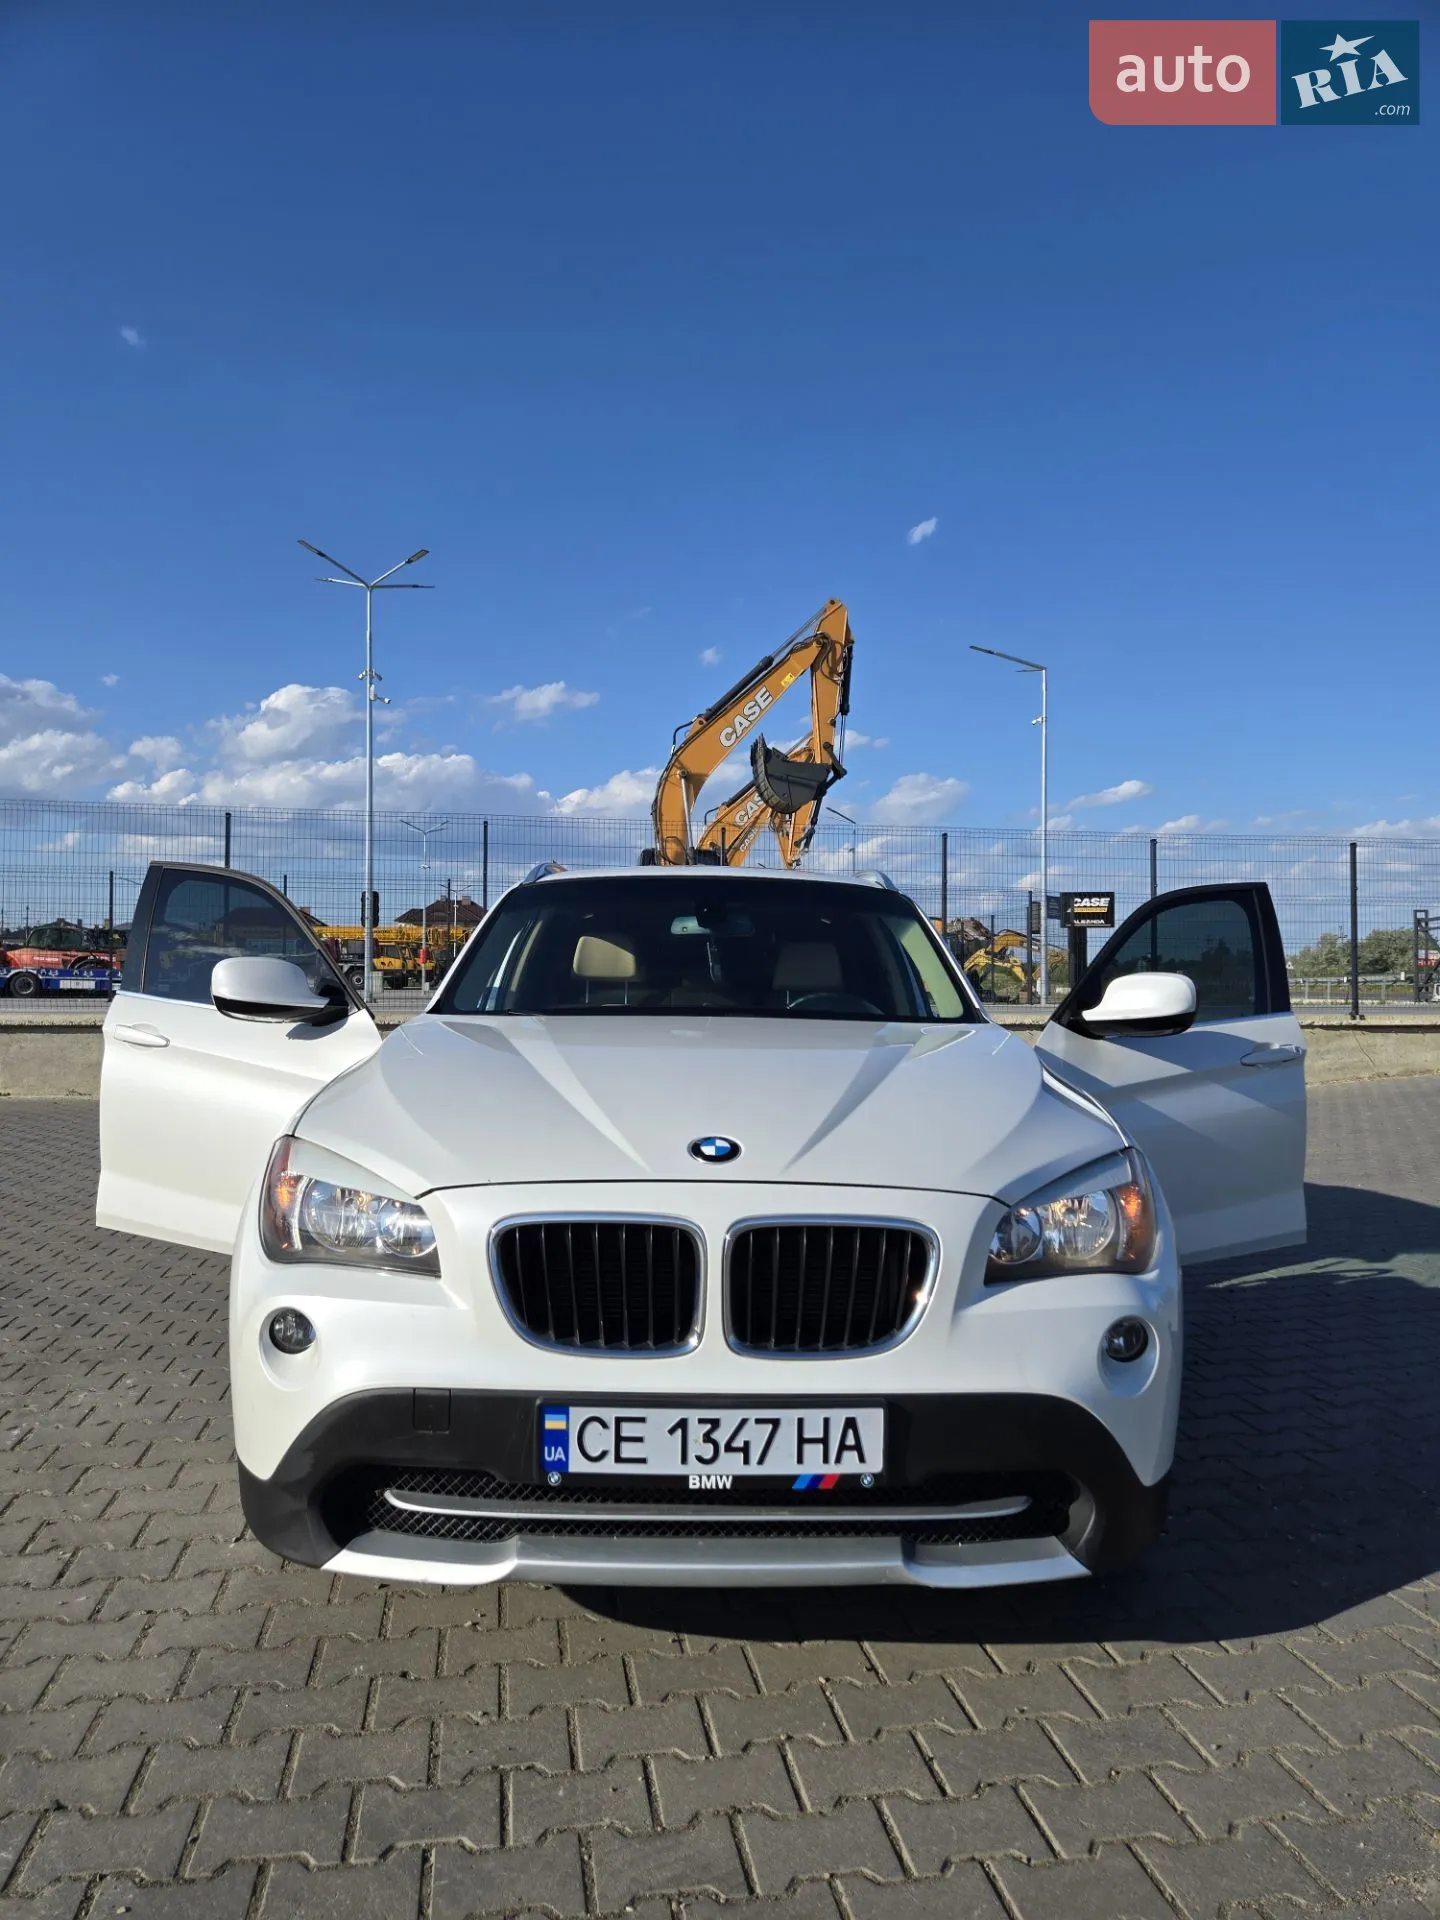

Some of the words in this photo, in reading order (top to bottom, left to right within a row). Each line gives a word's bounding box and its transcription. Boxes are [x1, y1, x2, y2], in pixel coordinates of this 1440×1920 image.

[719, 685, 774, 747] CASE
[735, 792, 765, 826] CAS
[1073, 897, 1110, 907] CASE
[576, 1415, 648, 1465] CE
[666, 1417, 781, 1466] 1347
[796, 1416, 867, 1466] HA
[544, 1445, 566, 1463] UA
[688, 1475, 733, 1490] BMW
